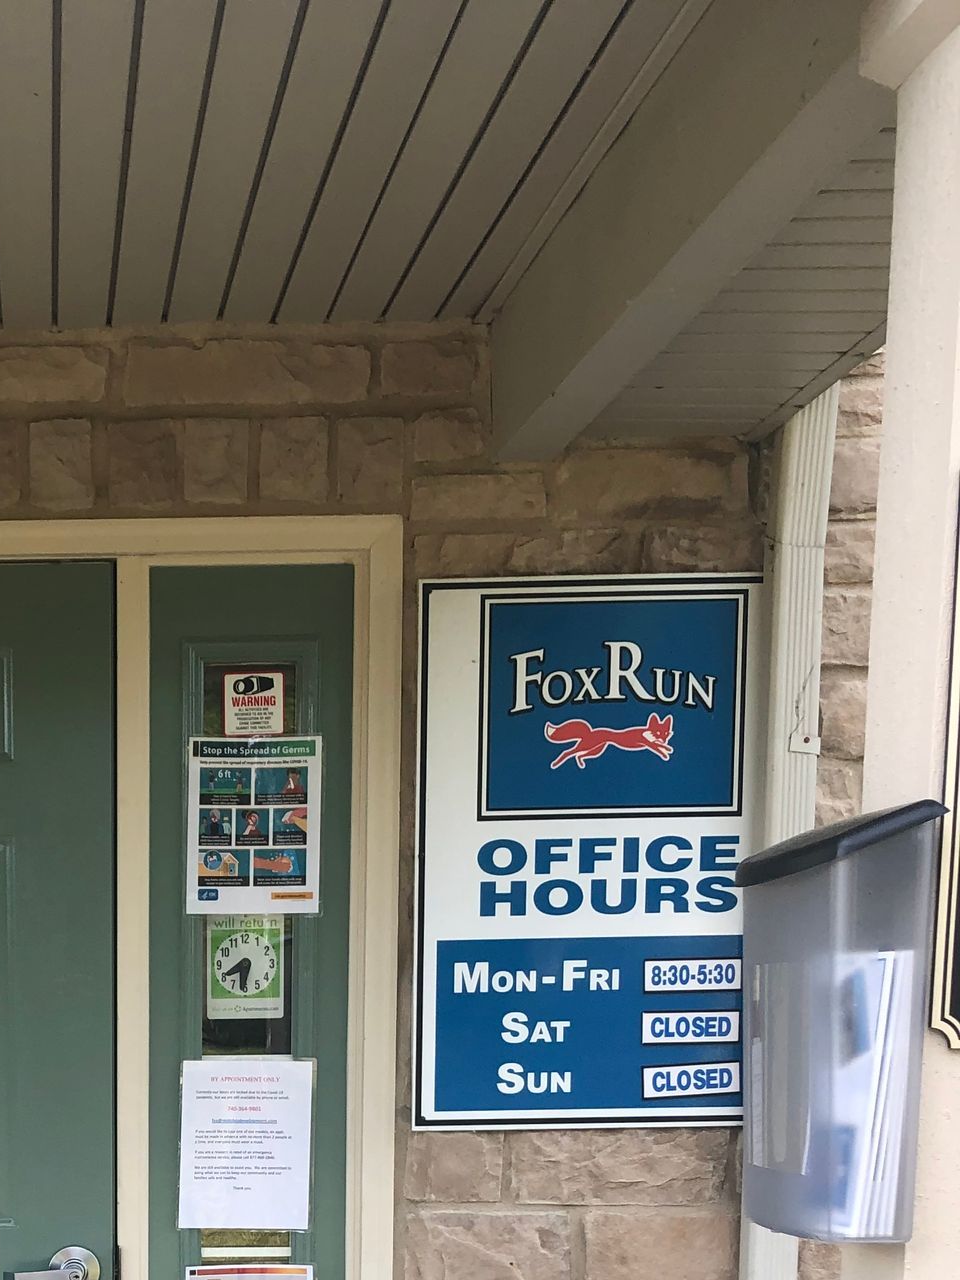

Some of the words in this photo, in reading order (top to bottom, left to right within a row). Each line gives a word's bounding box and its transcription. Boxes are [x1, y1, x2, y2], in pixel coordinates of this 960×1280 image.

[231, 695, 277, 708] WARNING
[202, 746, 222, 756] Stop
[224, 746, 238, 754] the
[239, 746, 270, 756] Spread
[271, 745, 280, 754] of
[282, 745, 310, 754] Germs
[218, 769, 223, 778] 6
[224, 769, 231, 778] ft
[477, 835, 739, 876] OFFICE
[479, 876, 738, 916] HOURS
[214, 915, 235, 928] will
[229, 938, 238, 948] 11
[240, 933, 249, 944] 12
[255, 936, 259, 946] 1
[220, 947, 229, 957] 10
[264, 945, 270, 956] 2
[216, 960, 222, 970] 9
[269, 959, 275, 969] 3
[263, 972, 269, 982] 4
[651, 964, 736, 986] 8:30-5:30
[230, 980, 236, 989] 7
[255, 980, 260, 989] 5
[650, 1017, 731, 1038] CLOSED
[652, 1068, 732, 1092] CLOSED
